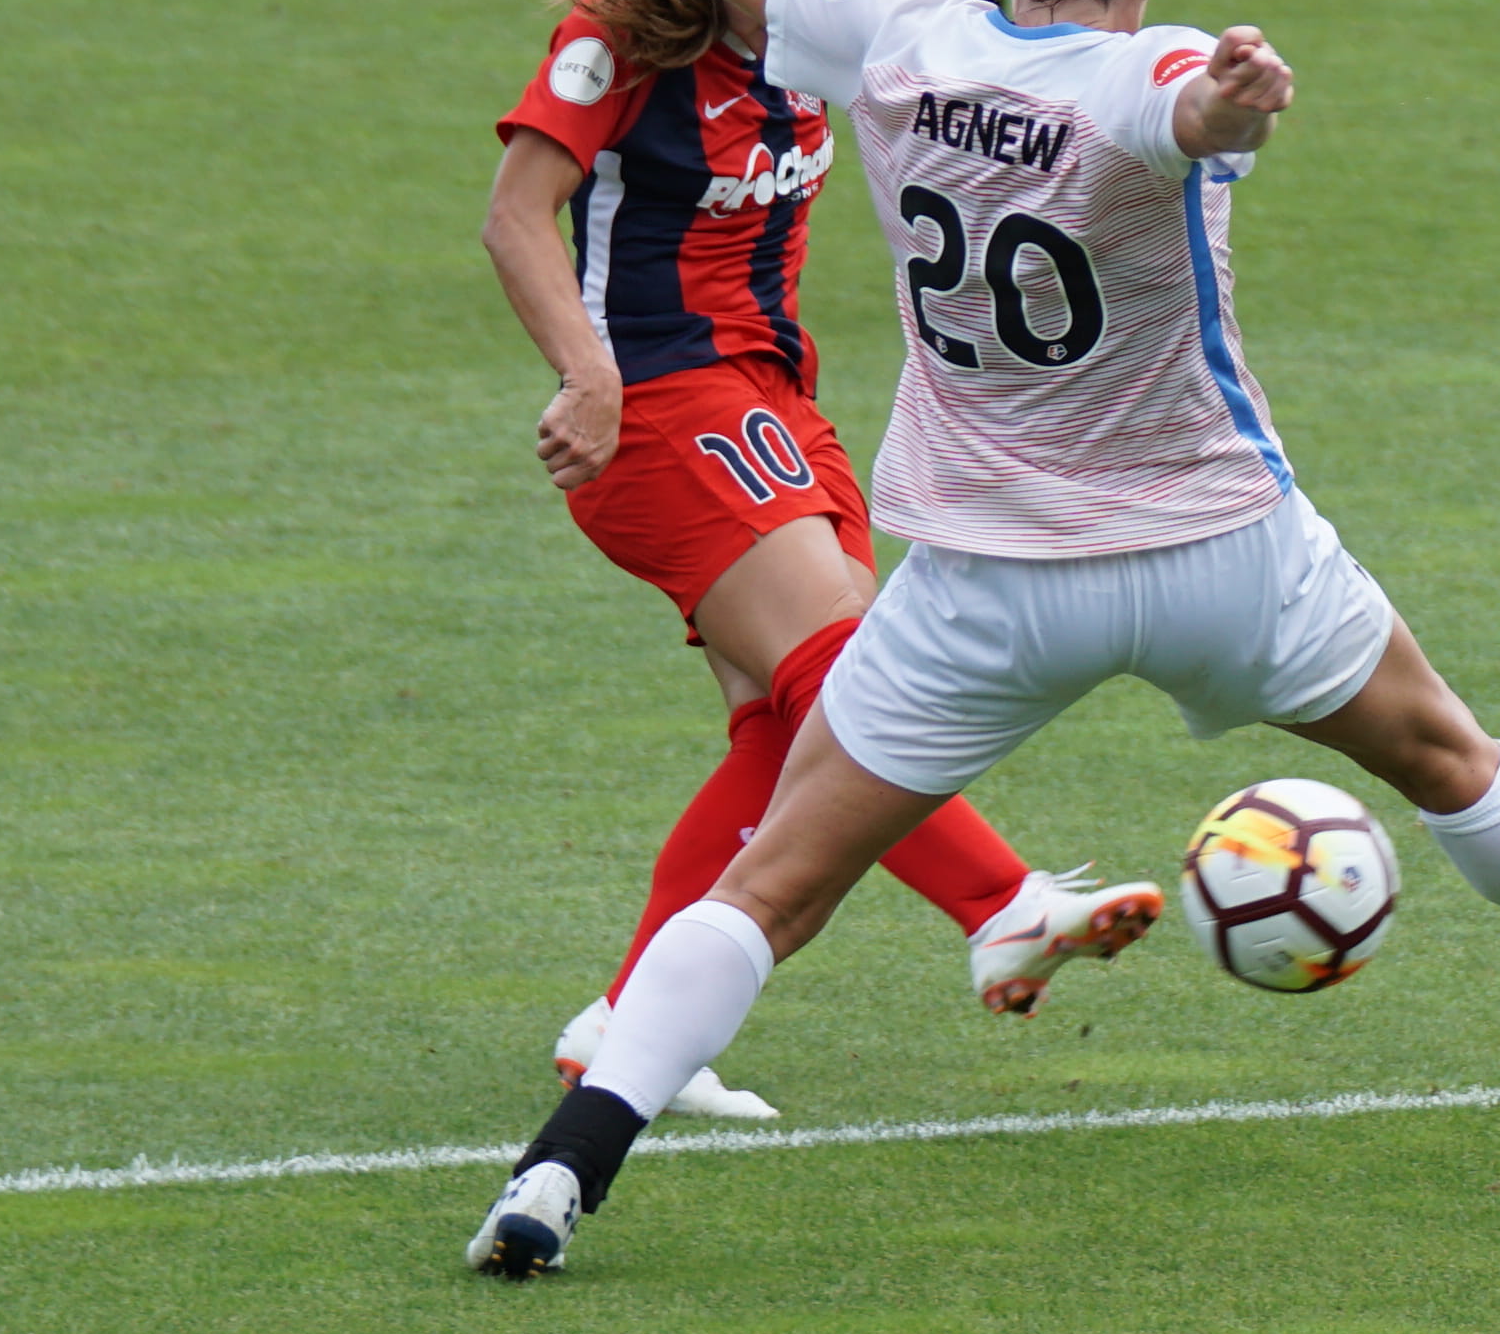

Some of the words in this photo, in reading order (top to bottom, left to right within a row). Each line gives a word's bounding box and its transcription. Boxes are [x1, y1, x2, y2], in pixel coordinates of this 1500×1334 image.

[556, 61, 605, 89] LIFETIME
[912, 92, 1074, 173] AGNEW
[899, 183, 1108, 370] 20
[694, 407, 815, 505] 10
